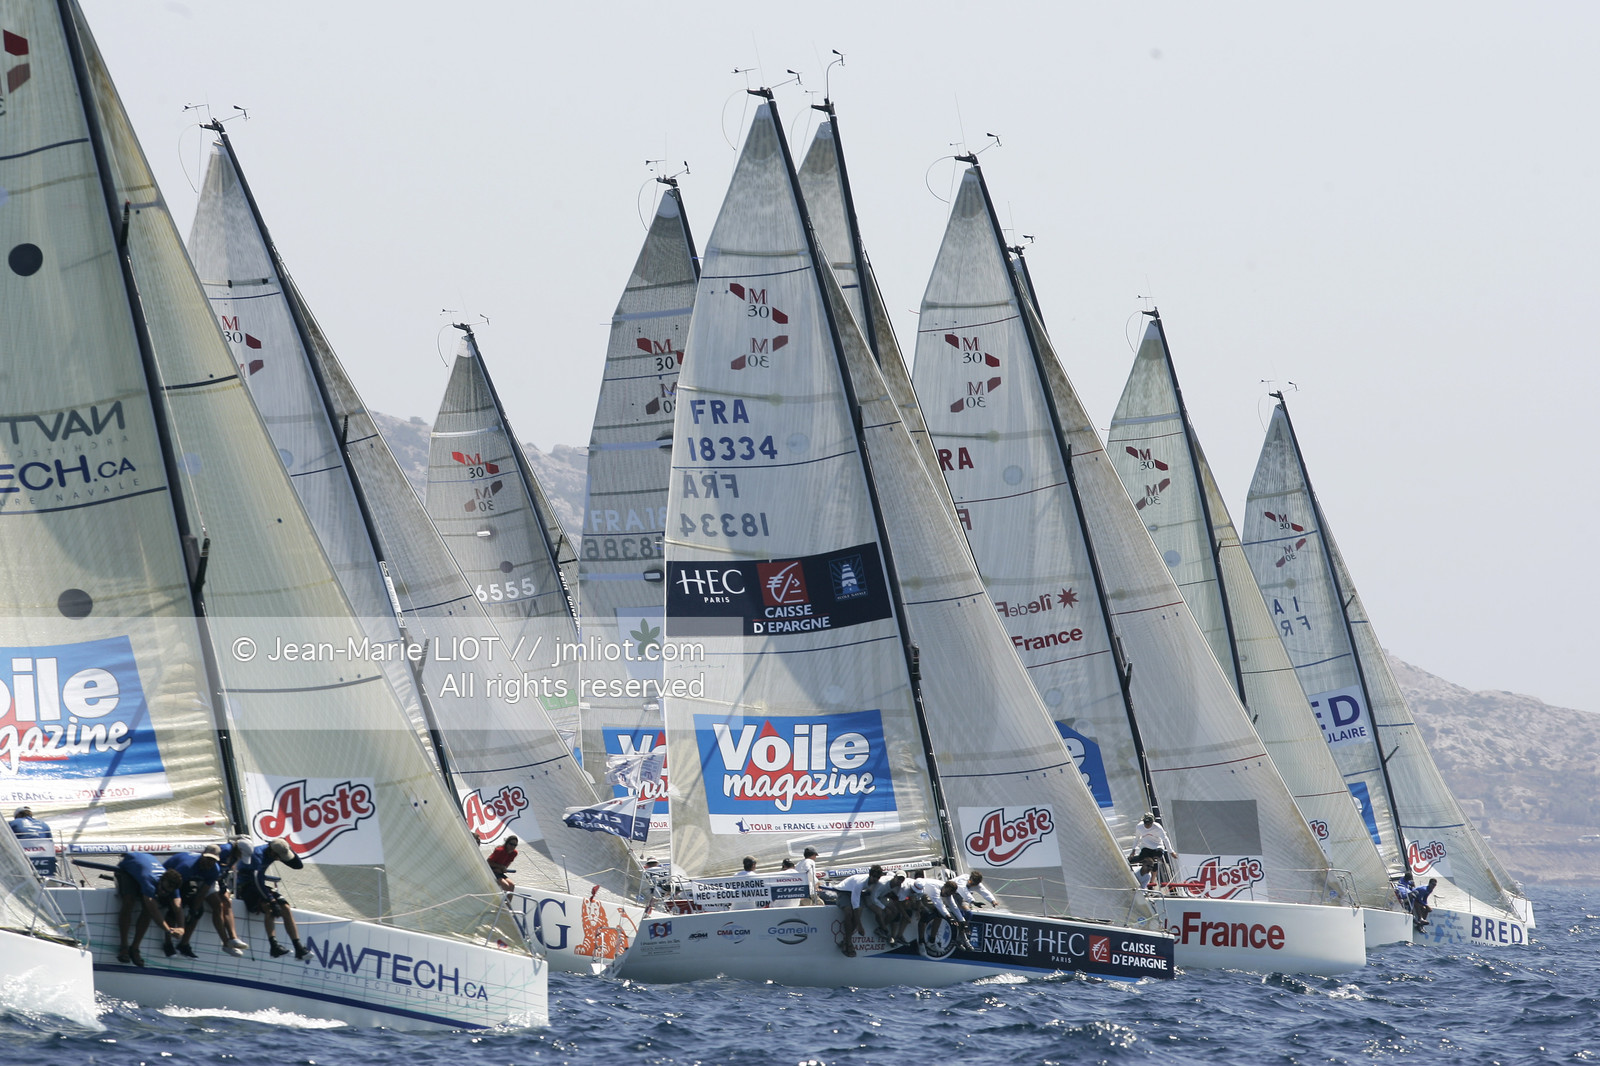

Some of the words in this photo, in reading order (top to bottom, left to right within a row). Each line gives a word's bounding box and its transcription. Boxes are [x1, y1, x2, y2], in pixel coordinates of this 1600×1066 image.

[749, 288, 768, 304] M
[747, 305, 769, 318] 30
[221, 316, 239, 330] M
[653, 339, 672, 354] M
[962, 337, 980, 351] M
[656, 357, 674, 371] 30
[962, 352, 982, 364] 30
[690, 399, 750, 424] FRA
[687, 435, 778, 462] 18334
[1139, 448, 1152, 460] M
[465, 453, 483, 466] M
[1140, 461, 1154, 470] 30
[469, 467, 484, 479] 30
[56, 478, 139, 501] NAVALE
[475, 577, 536, 601] 6555
[676, 569, 746, 594] HEC
[764, 604, 813, 618] CAISSE
[753, 616, 831, 634] D'EPARGNE
[1011, 628, 1083, 651] France
[712, 723, 870, 773] Voile
[108, 787, 135, 797] 2007
[723, 768, 876, 812] magazine
[258, 786, 372, 838] Aoste
[466, 789, 526, 828] Aoste
[750, 823, 773, 831] TOUR
[783, 822, 815, 830] FRANCE
[829, 821, 853, 829] VOILE
[854, 820, 874, 829] 2007
[969, 810, 1051, 853] Aoste
[1408, 842, 1445, 866] Aoste
[698, 881, 723, 891] CAISSE
[725, 880, 765, 890] D'EPARGNE
[1187, 860, 1262, 895] Aoste
[696, 891, 711, 900] HEC
[716, 890, 740, 899] ECOLE
[741, 888, 769, 897] NAVALE
[768, 926, 818, 935] Gamelin
[984, 923, 1029, 942] ECOLE
[1471, 915, 1523, 944] BRED
[982, 938, 1029, 957] NAVALE
[1033, 929, 1084, 957] HEC
[1121, 941, 1156, 955] CAISSE
[1051, 956, 1072, 964] PARIS
[1112, 955, 1168, 971] D'EPARGNE
[305, 936, 489, 1001] NAVTECH.CA
